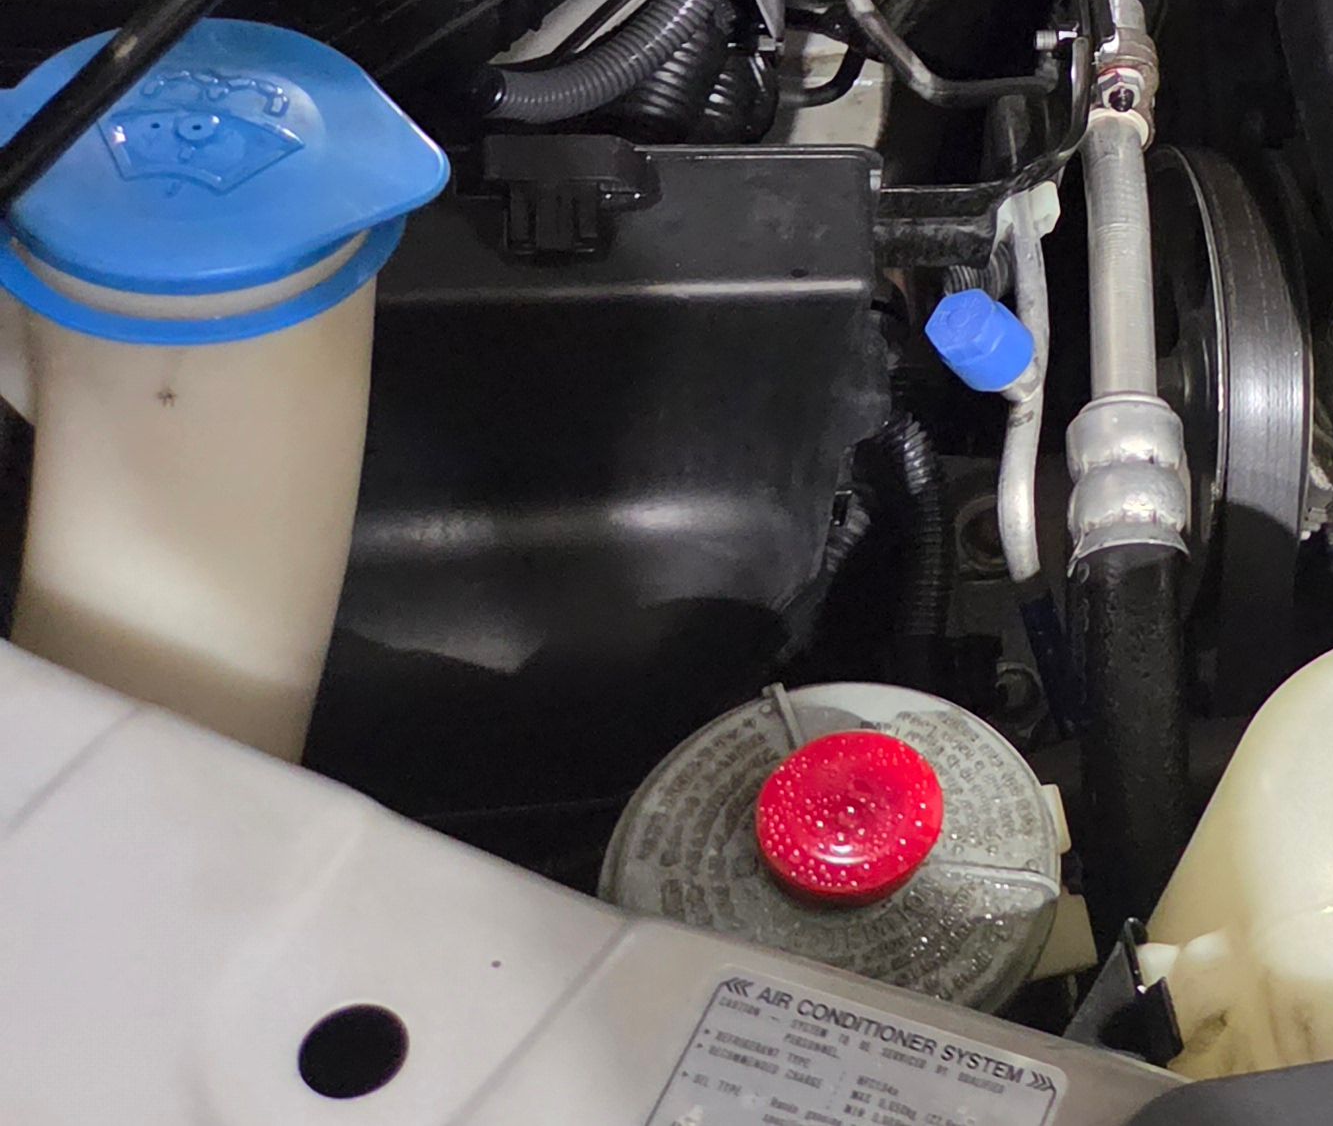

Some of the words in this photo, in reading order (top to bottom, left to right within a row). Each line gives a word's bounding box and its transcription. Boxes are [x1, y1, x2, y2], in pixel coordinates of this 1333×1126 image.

[756, 985, 793, 1009] AIR
[795, 998, 938, 1055] CONDITIONER
[939, 1043, 1024, 1083] SYSTEM
